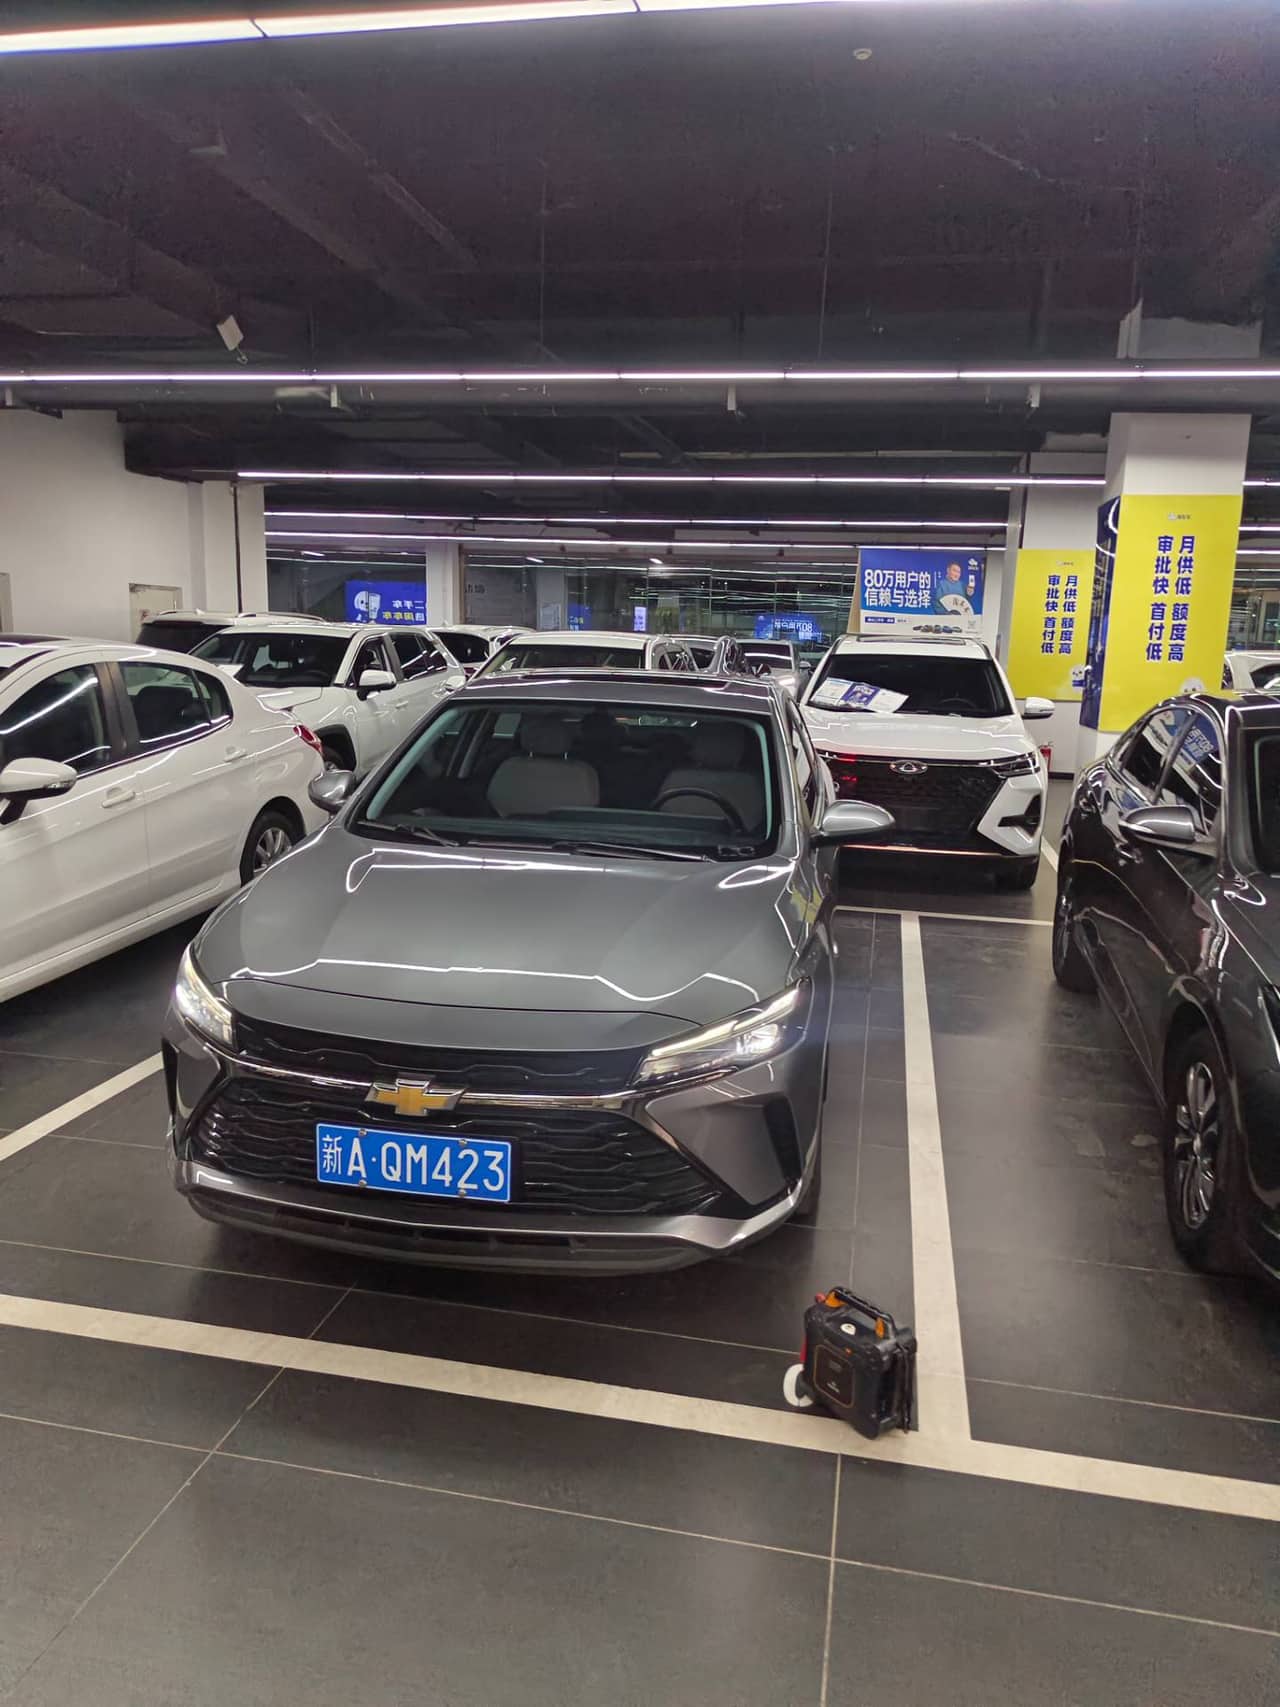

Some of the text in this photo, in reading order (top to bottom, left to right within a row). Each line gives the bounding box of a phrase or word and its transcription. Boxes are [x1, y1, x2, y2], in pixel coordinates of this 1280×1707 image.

[864, 568, 931, 589] 80万用户的
[1063, 575, 1078, 612] 月供低
[1175, 536, 1195, 595] 月供低
[865, 588, 931, 608] 信赖与选择
[1041, 575, 1060, 653] 审批快 首付低
[1146, 535, 1174, 661] 审批快 首付低
[1168, 603, 1189, 661] 额度高
[322, 1134, 505, 1192] 新A·QM423
